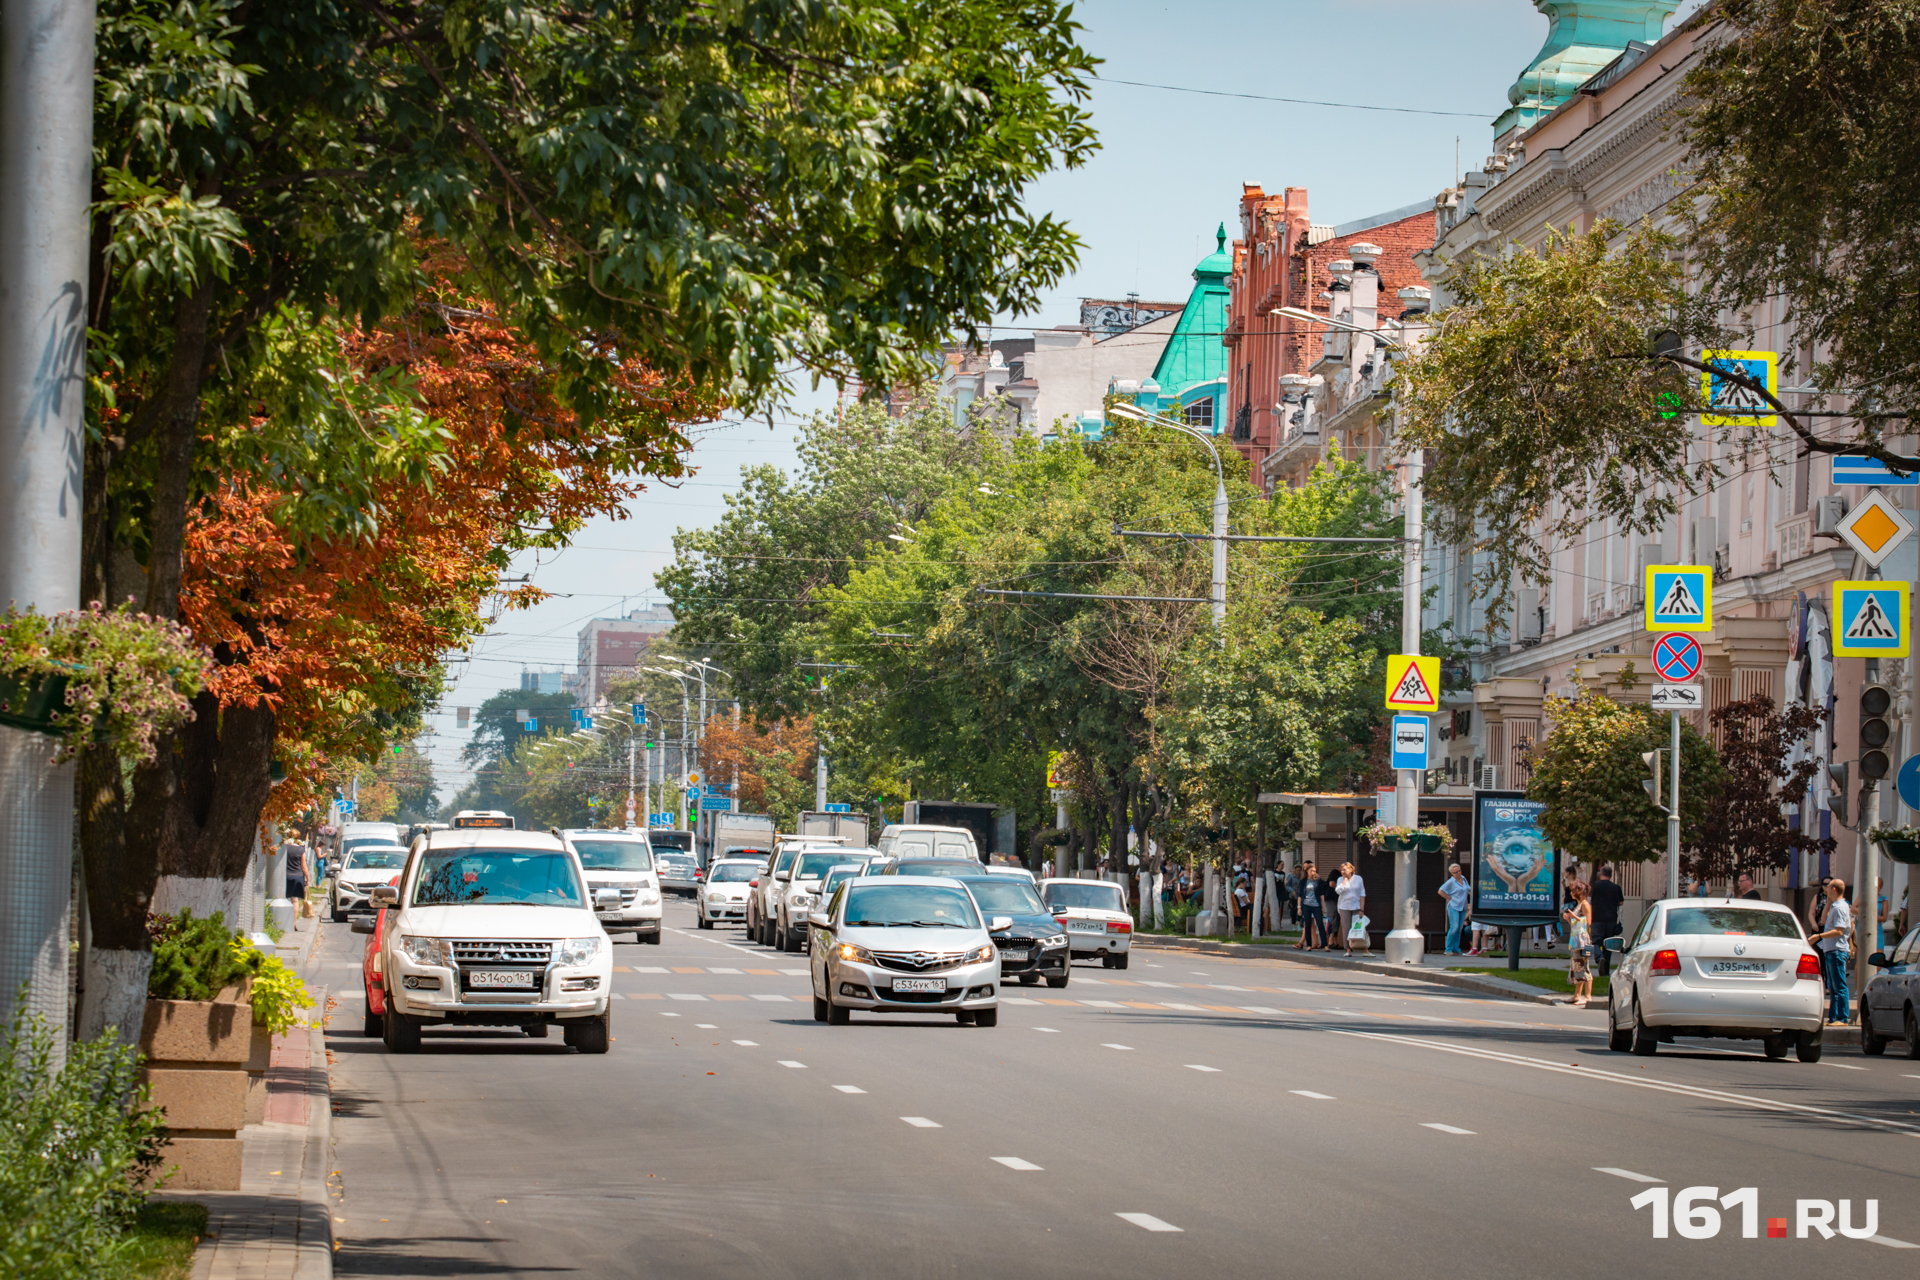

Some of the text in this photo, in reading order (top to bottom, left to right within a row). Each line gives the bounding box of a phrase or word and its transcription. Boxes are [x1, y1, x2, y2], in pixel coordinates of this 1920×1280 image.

[1484, 800, 1517, 808] ГЛАЗНАЯ
[1514, 814, 1538, 823] ЮНО
[1504, 893, 1550, 901] 2-01-01-01
[1712, 962, 1750, 972] А395РМ
[515, 972, 530, 980] 161
